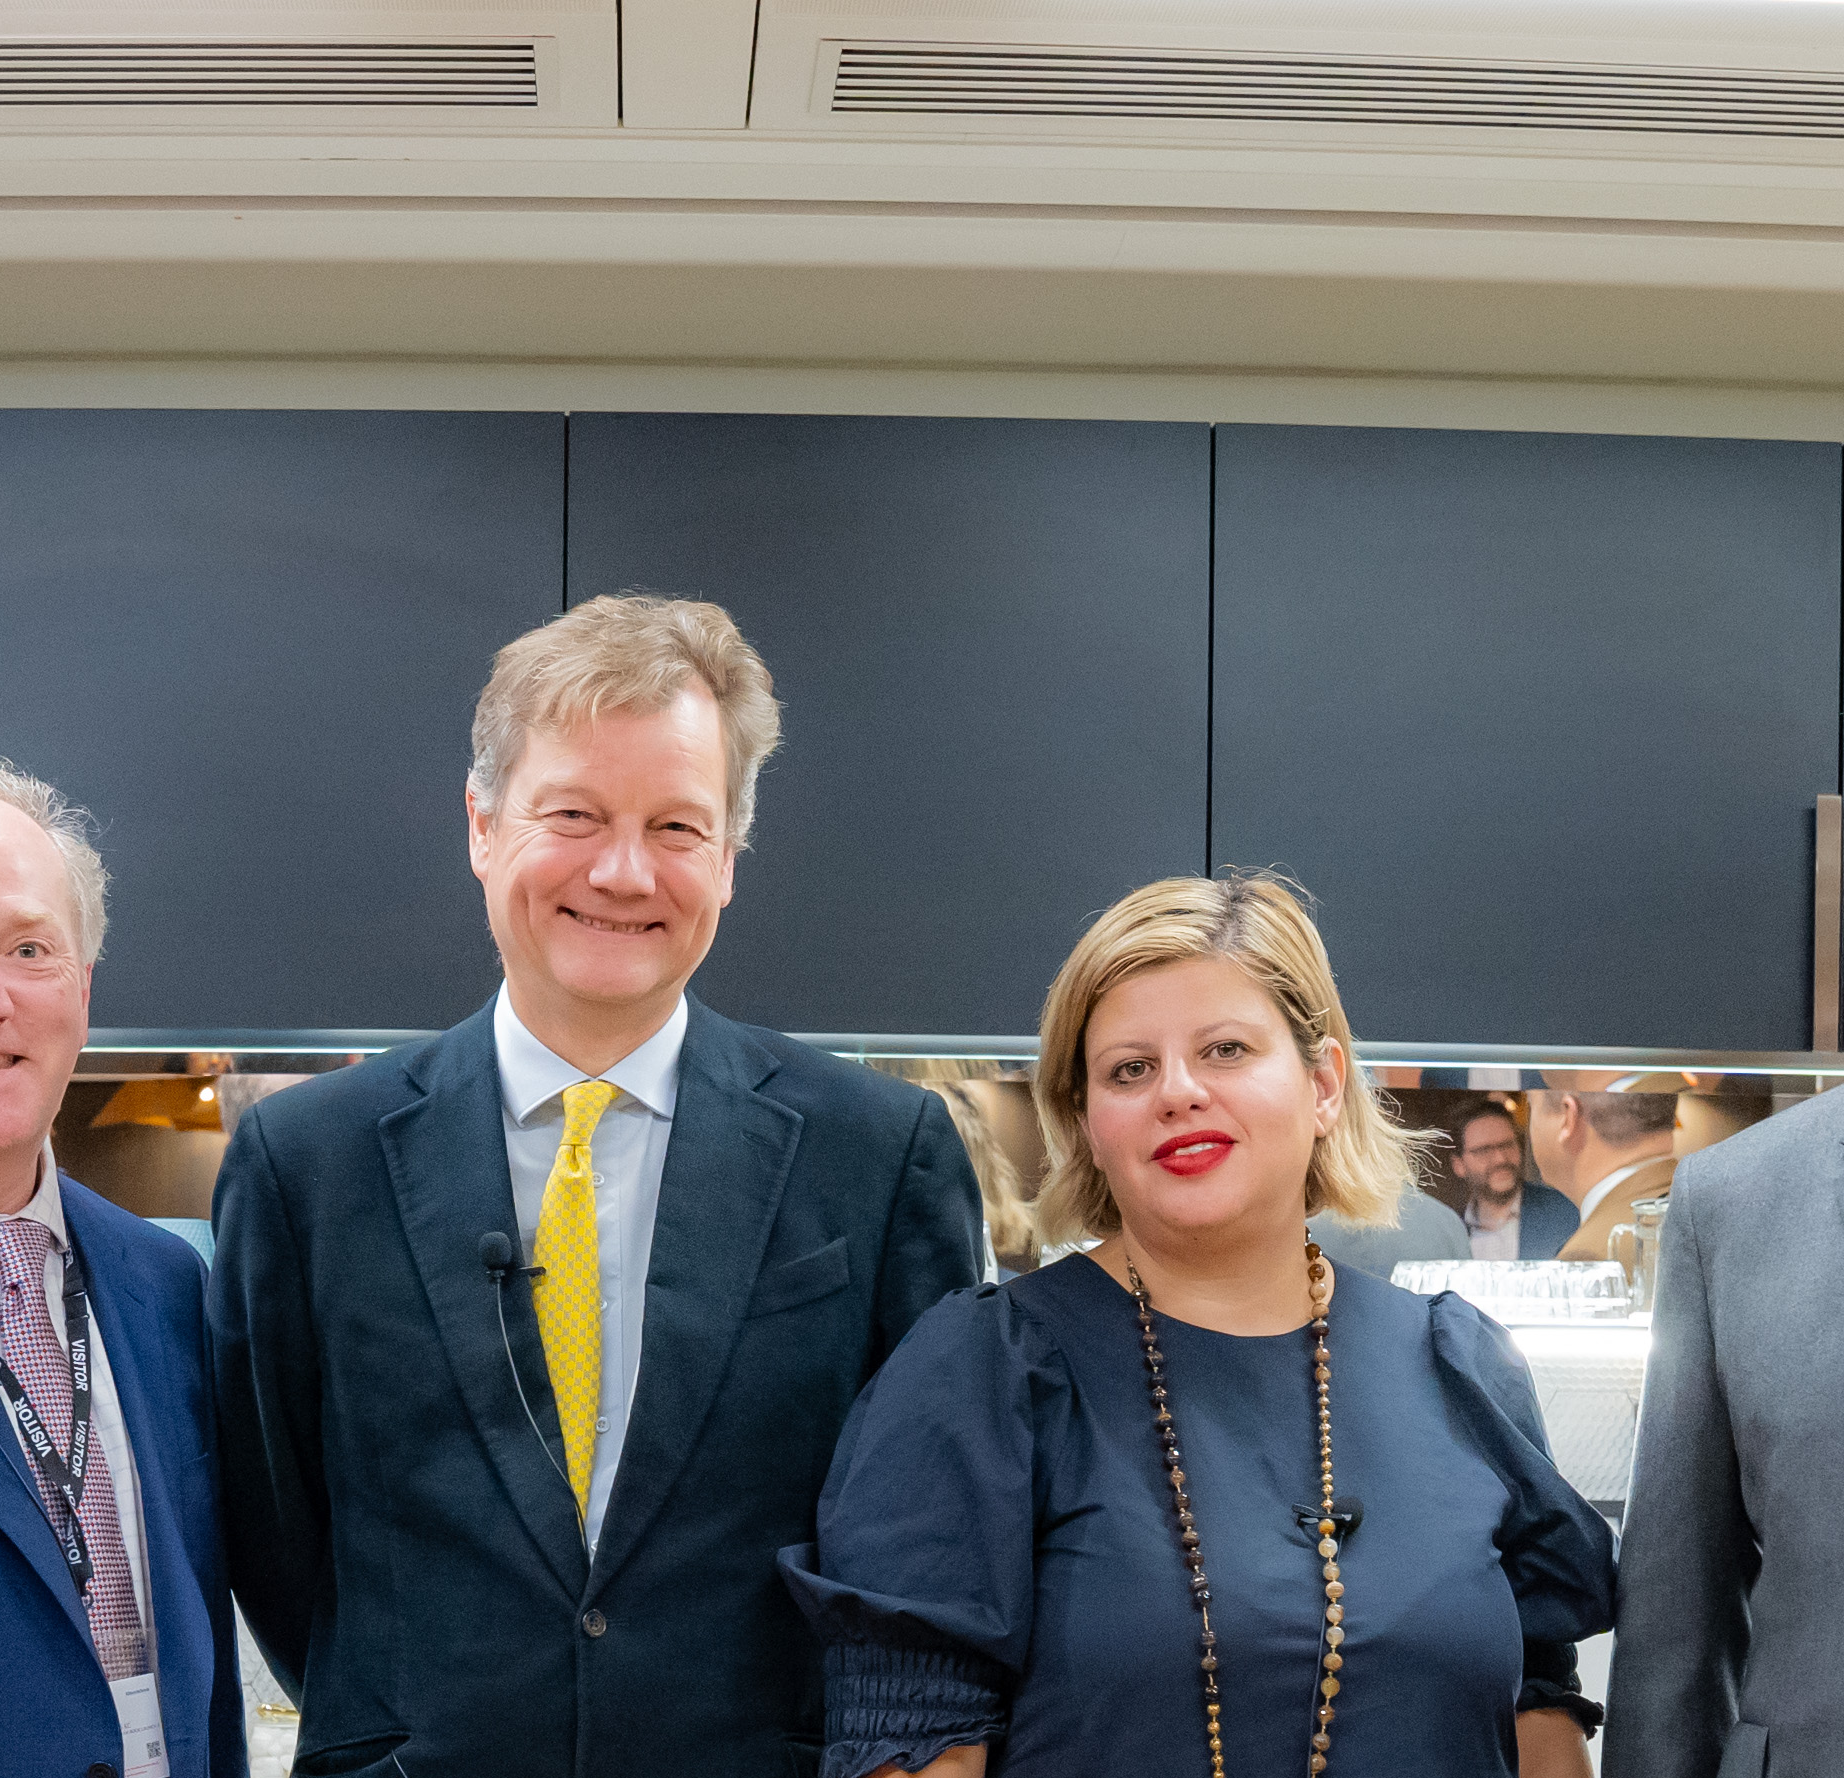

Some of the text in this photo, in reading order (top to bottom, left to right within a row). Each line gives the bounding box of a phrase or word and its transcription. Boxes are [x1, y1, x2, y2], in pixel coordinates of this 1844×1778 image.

[71, 1338, 89, 1392] VISITOR
[13, 1396, 53, 1458] VISITOR
[71, 1420, 87, 1478] VISITOR
